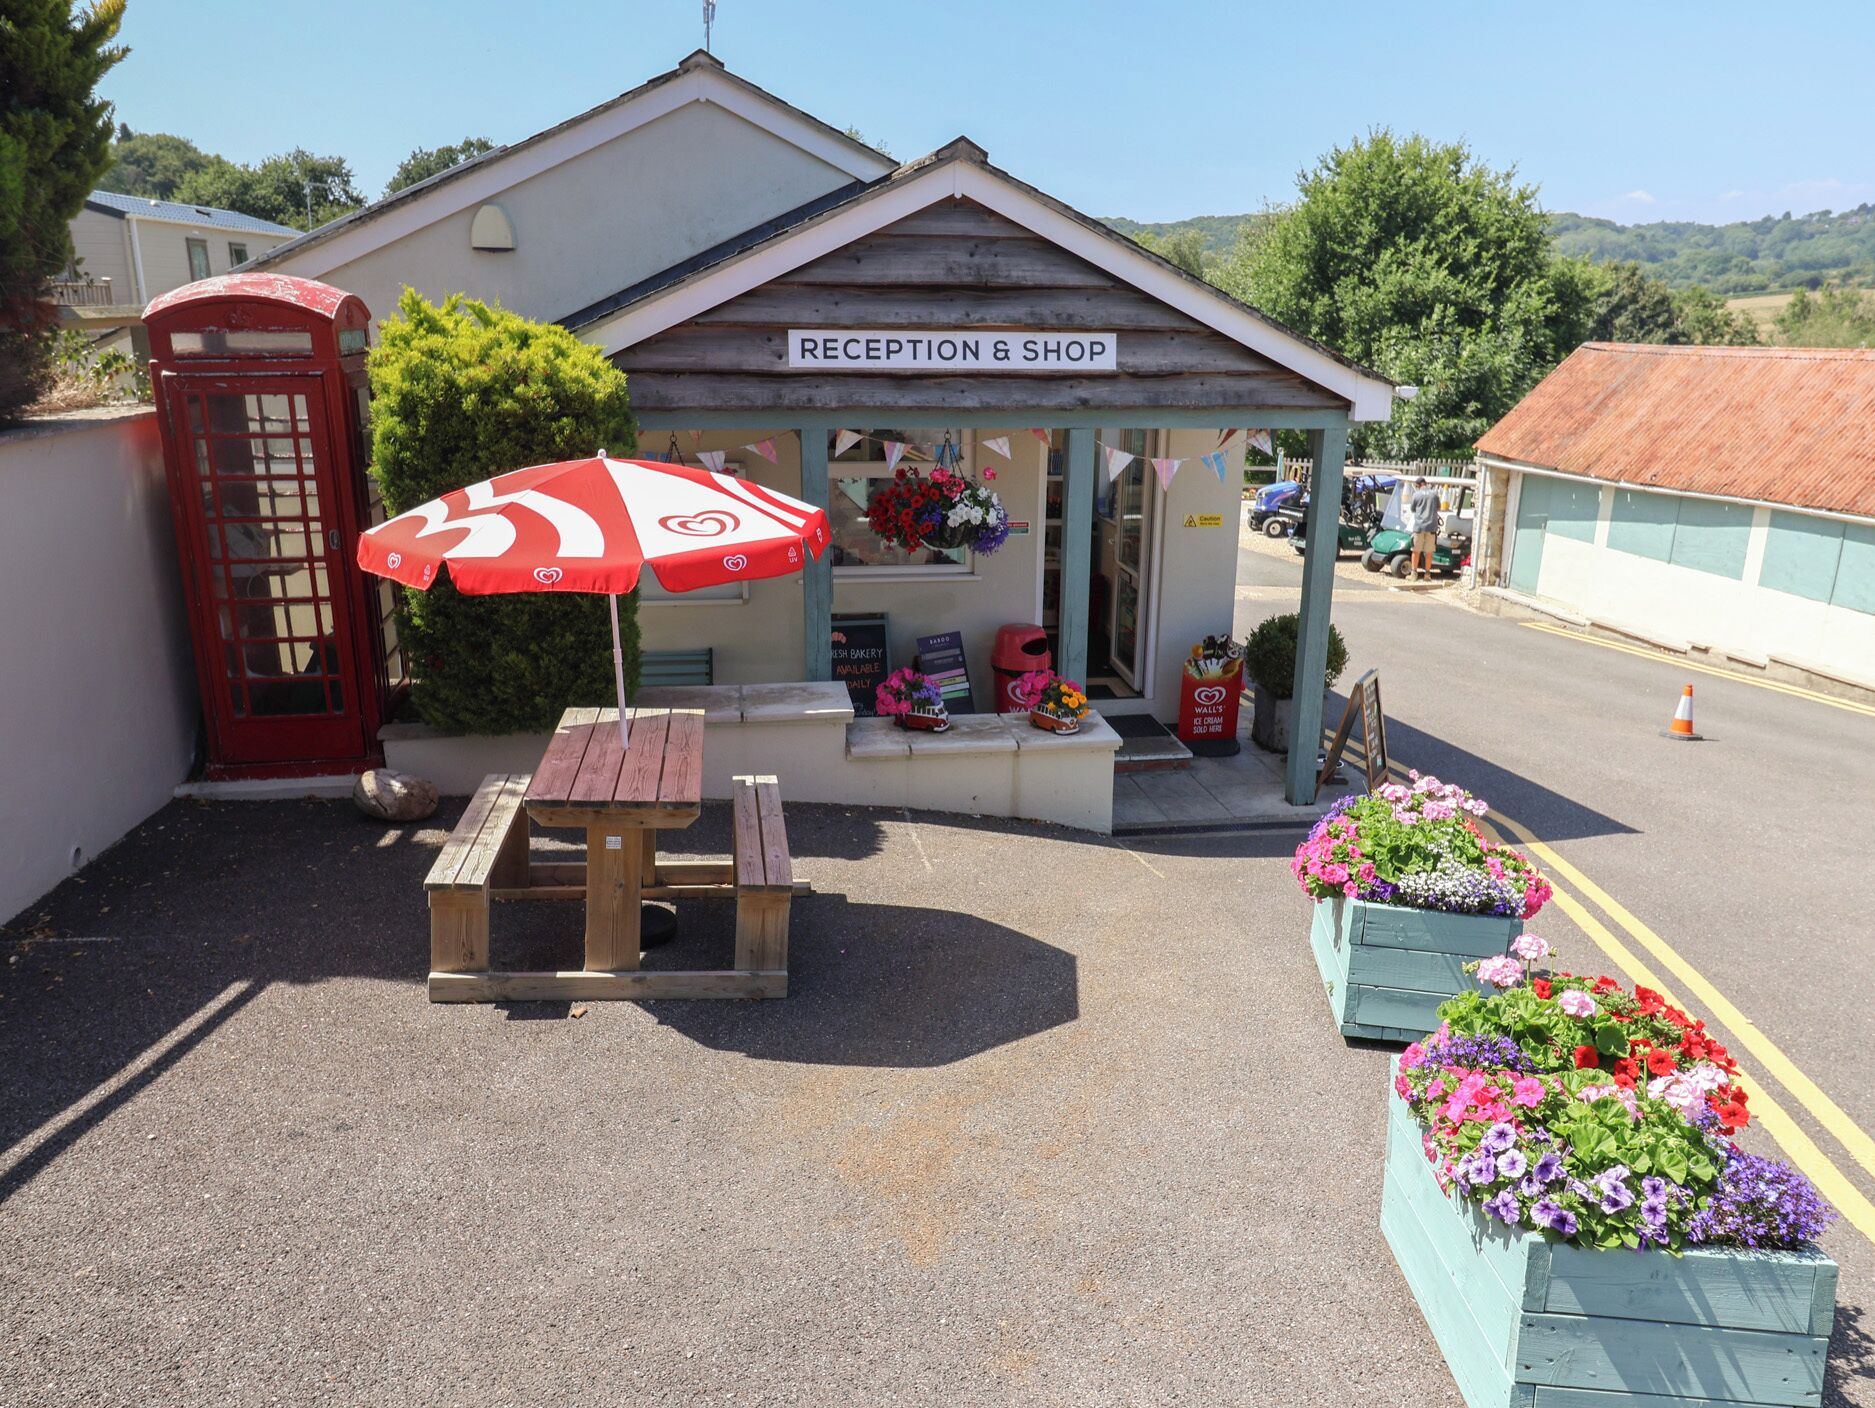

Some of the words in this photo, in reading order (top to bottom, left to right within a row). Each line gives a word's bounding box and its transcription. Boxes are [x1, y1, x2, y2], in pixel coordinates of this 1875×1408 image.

[800, 338, 980, 361] RECEPTION
[992, 340, 1010, 362] &
[1022, 340, 1107, 362] SHOP
[851, 648, 882, 659] BAKERY
[1194, 705, 1223, 713] WALL'S
[1203, 716, 1223, 724] CREAM
[1209, 724, 1222, 732] HERE
